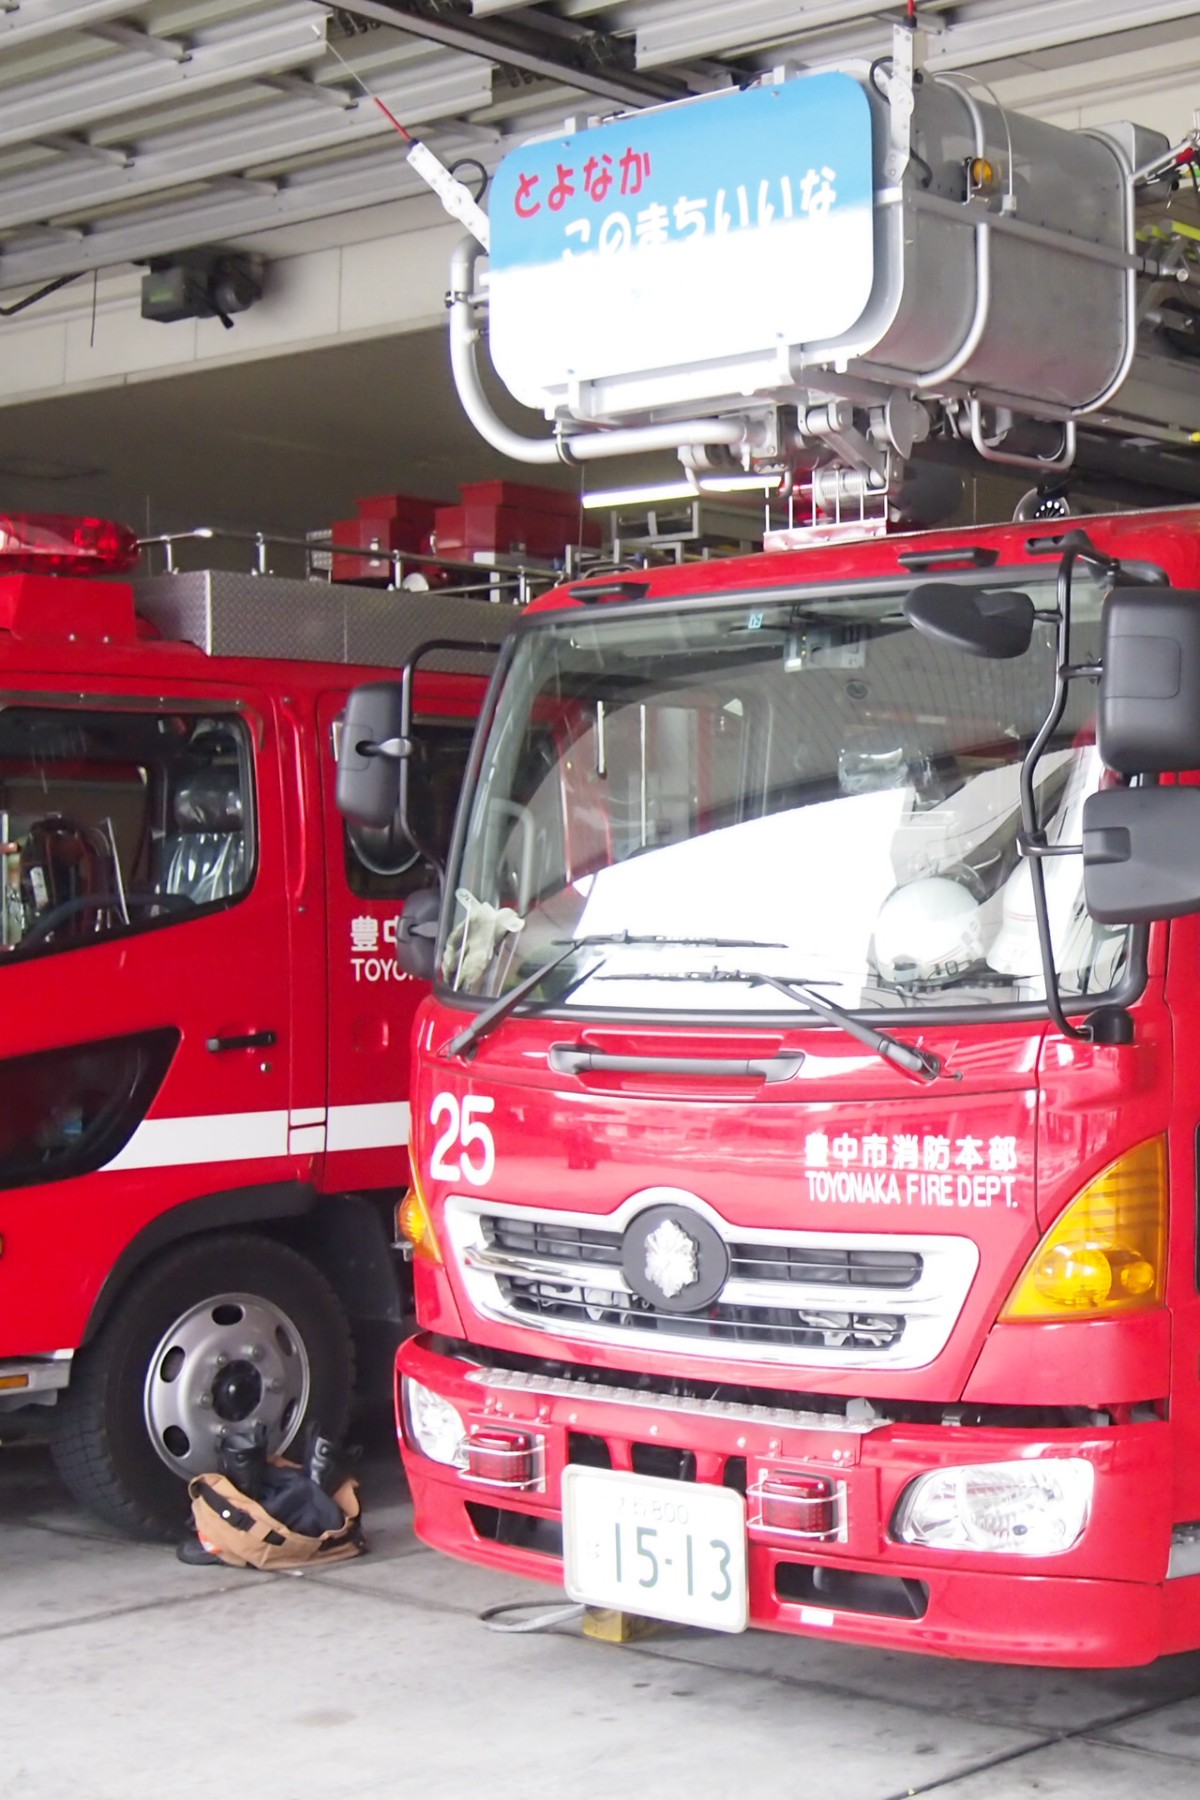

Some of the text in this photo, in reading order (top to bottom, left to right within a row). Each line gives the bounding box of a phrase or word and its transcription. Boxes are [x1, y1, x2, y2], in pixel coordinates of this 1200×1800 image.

[513, 146, 652, 219] とよなか
[561, 165, 837, 262] このまちいいな
[429, 1091, 496, 1187] 25
[804, 1132, 1018, 1172] 豊中市消防本部
[804, 1170, 1019, 1209] TOYONAKA FIRE DEPT.
[614, 1521, 733, 1602] 15-13
